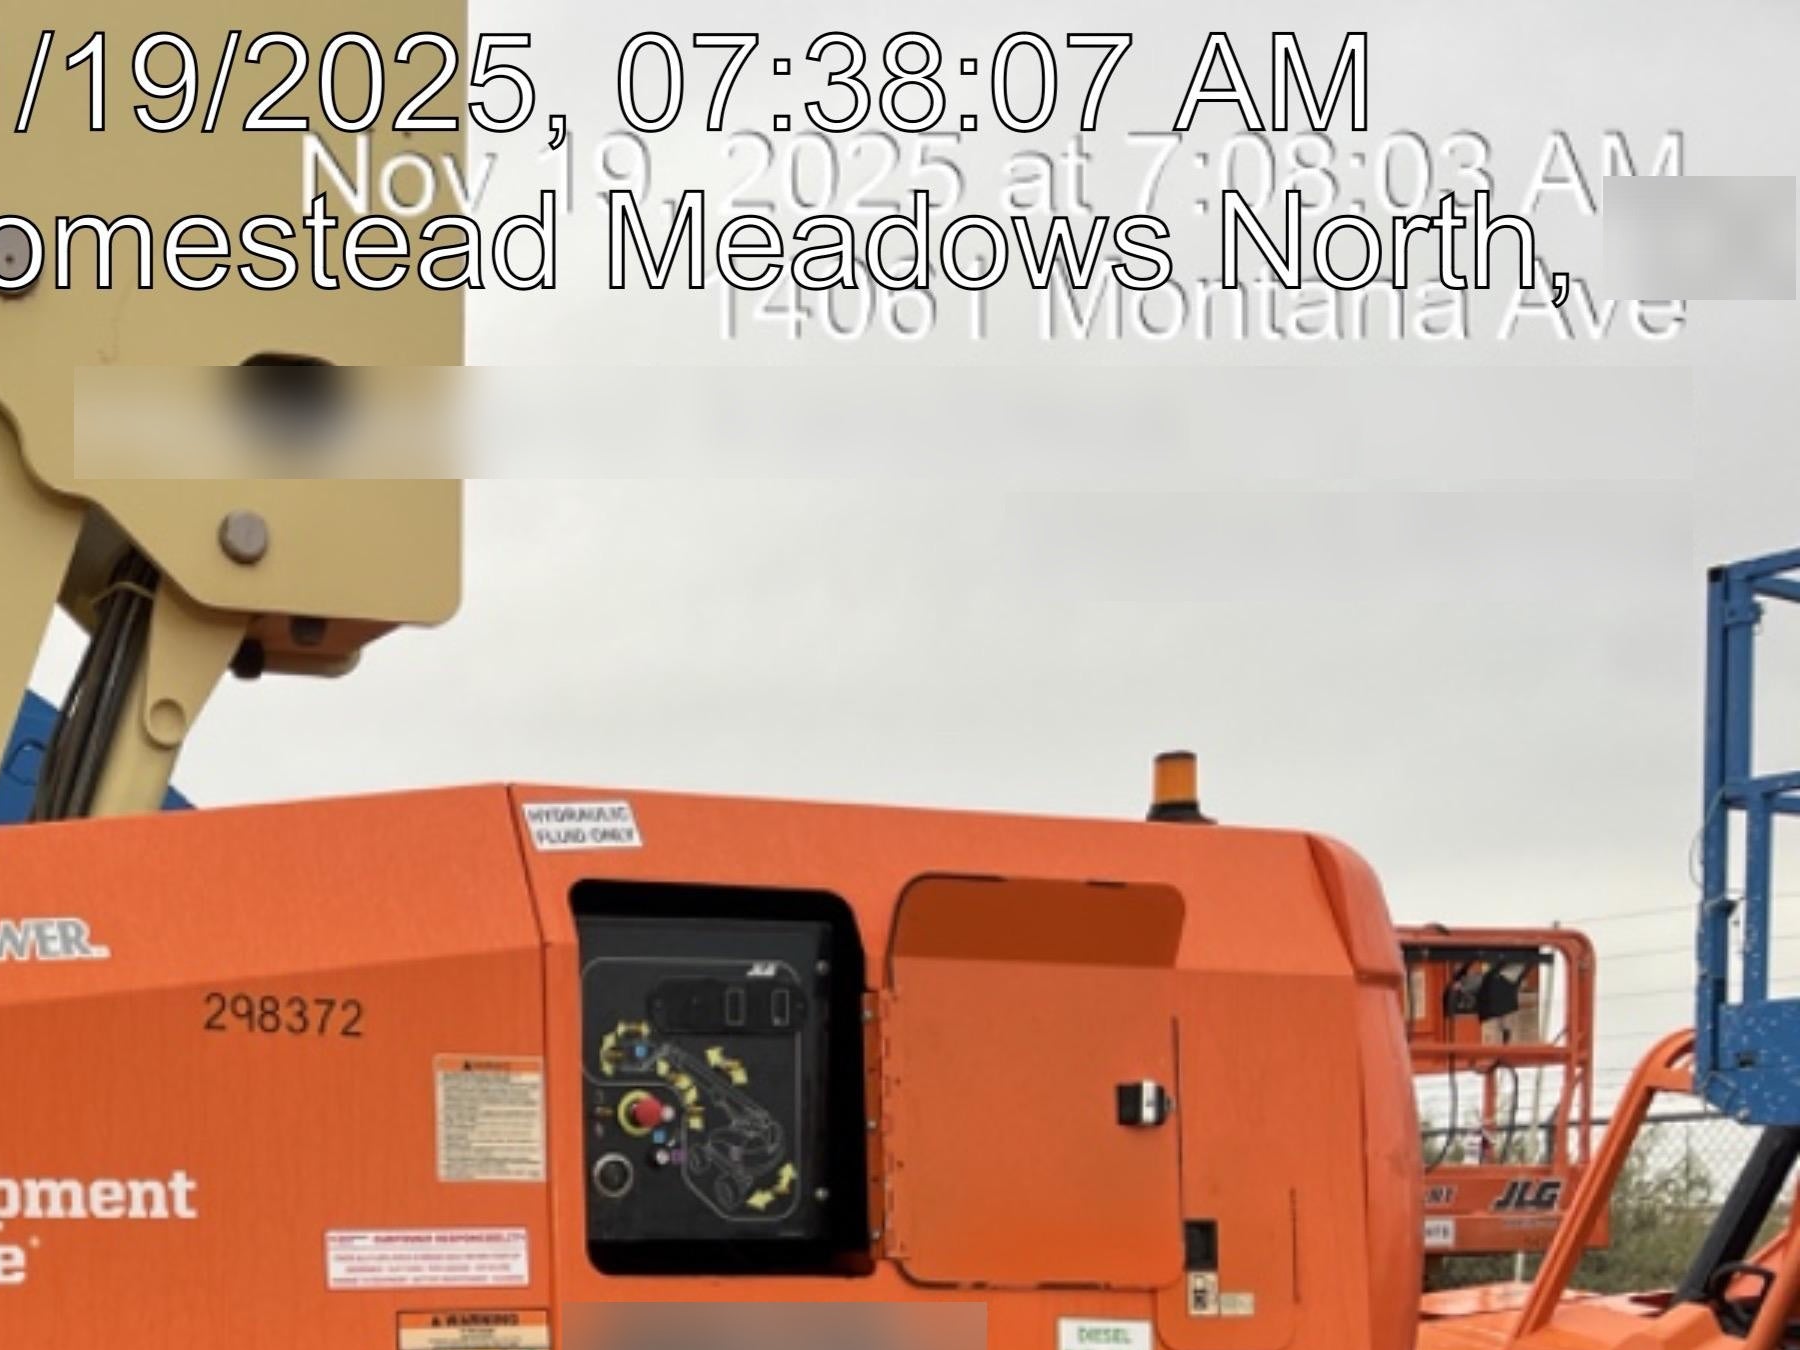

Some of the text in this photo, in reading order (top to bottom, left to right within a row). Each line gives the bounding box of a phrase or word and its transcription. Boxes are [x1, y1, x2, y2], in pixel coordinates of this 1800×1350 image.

[525, 805, 628, 823] HYDRAULIC
[535, 826, 634, 845] FLUID ONLY
[203, 992, 363, 1038] 298372
[1492, 1179, 1563, 1212] JLG
[1077, 1326, 1132, 1345] DIESEL
